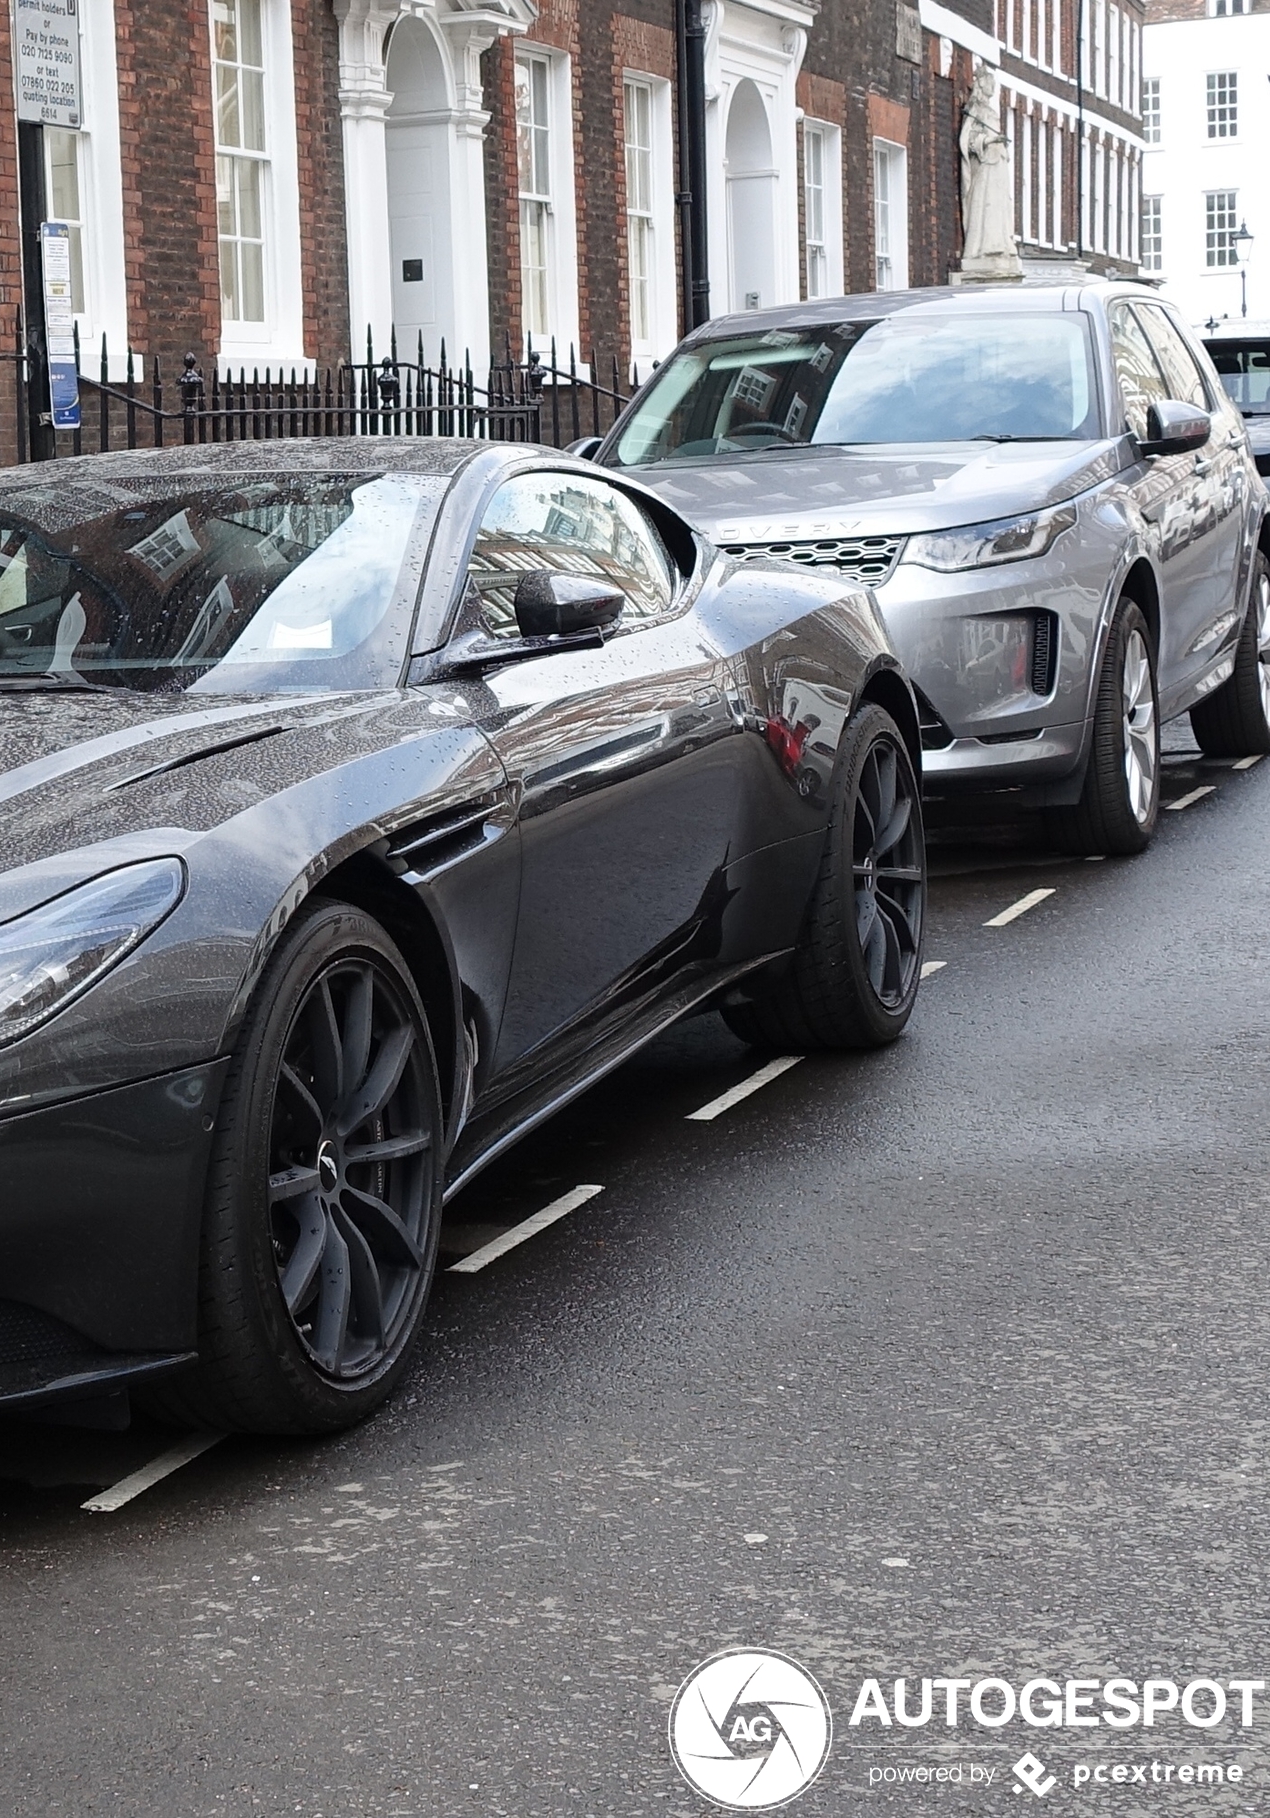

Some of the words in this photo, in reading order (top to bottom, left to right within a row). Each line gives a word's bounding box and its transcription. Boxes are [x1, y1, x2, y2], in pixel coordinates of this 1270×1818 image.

[18, 0, 40, 11] permit
[42, 1, 66, 16] holders
[44, 19, 51, 29] or
[26, 28, 38, 43] Pay
[40, 31, 48, 45] by
[49, 34, 69, 47] phone
[21, 44, 35, 58] 020
[38, 47, 53, 61] 7125
[55, 51, 73, 65] 9090
[36, 65, 44, 75] or
[46, 66, 59, 78] text
[46, 80, 60, 93] 022
[61, 82, 75, 95] 205
[23, 91, 48, 106] quoting
[50, 93, 75, 108] location
